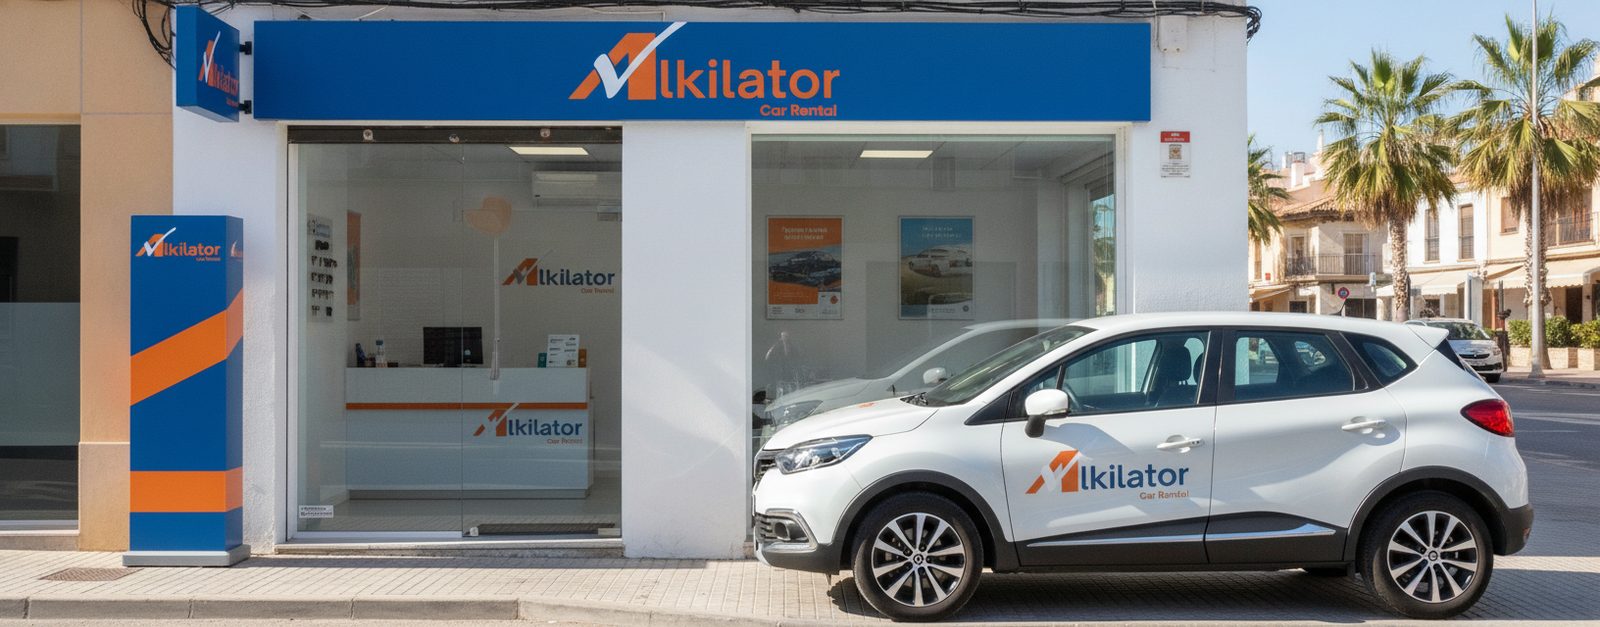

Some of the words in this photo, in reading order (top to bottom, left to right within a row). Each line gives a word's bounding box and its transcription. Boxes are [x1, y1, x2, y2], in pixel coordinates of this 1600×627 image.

[568, 22, 840, 100] Alkilator
[759, 104, 787, 117] Car
[790, 103, 838, 117] Rental
